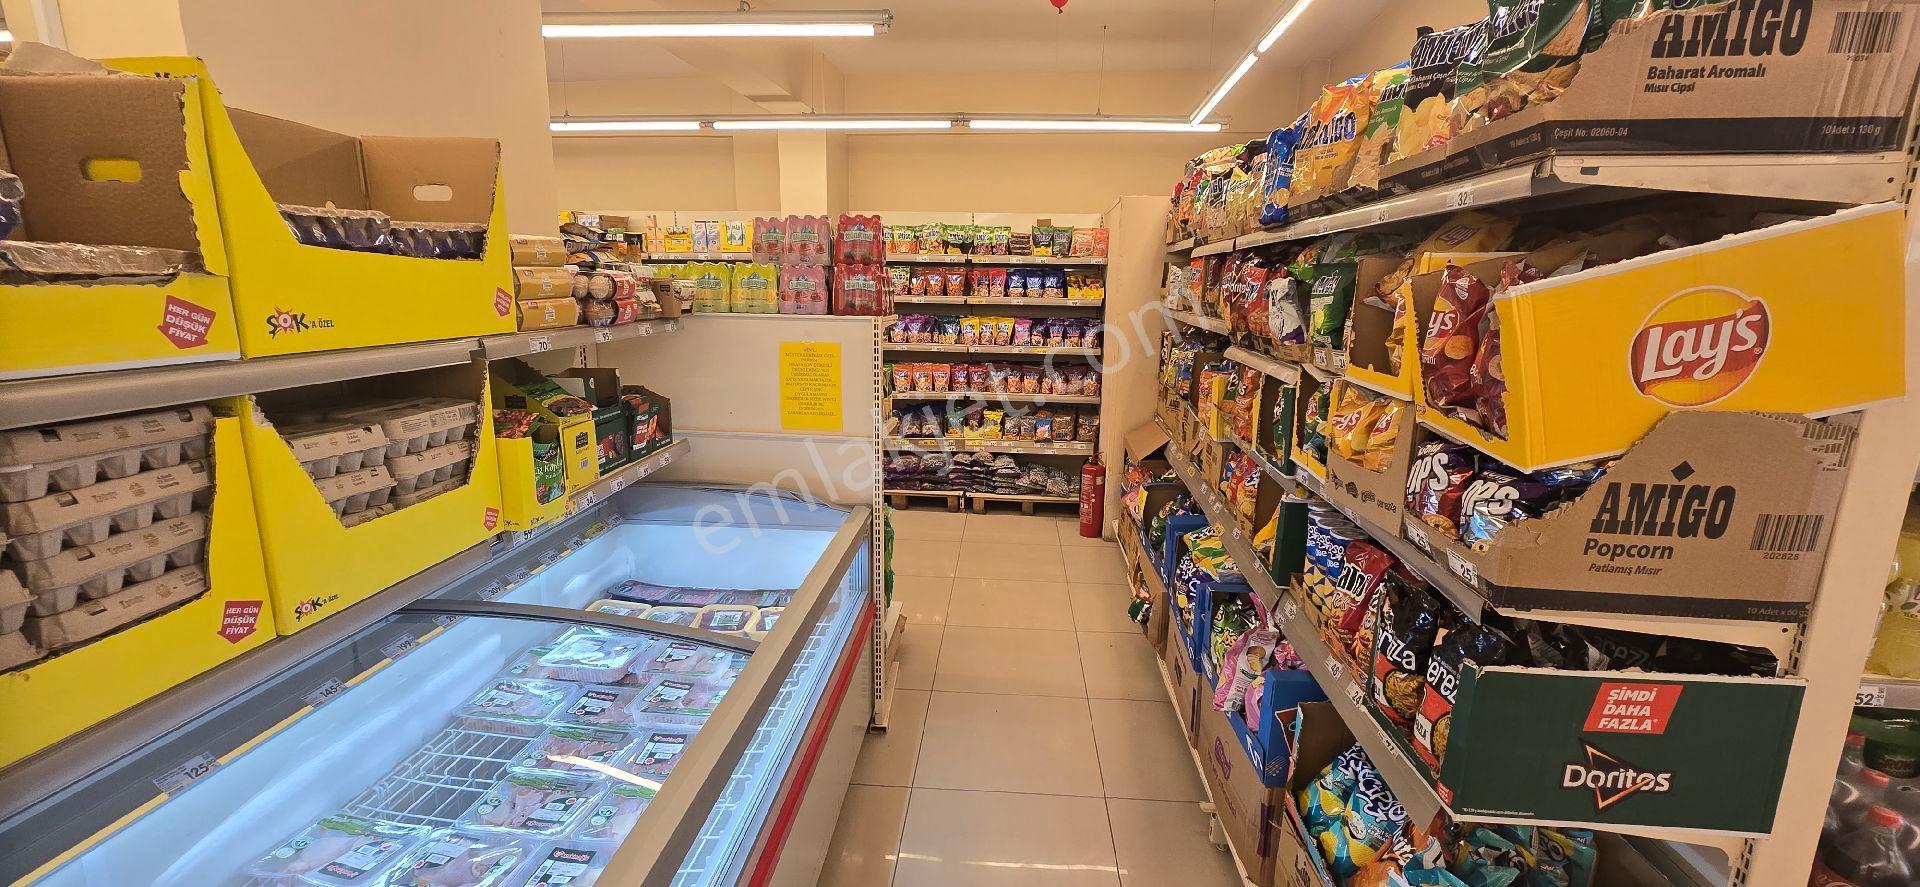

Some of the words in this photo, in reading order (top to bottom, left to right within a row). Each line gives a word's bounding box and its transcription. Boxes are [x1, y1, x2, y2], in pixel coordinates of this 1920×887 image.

[1647, 65, 1705, 80] Baharat
[1708, 63, 1766, 79] Aromalı
[1644, 83, 1669, 93] Mısır
[1670, 82, 1695, 94] Cipsi
[1575, 128, 1588, 137] No:
[1590, 128, 1628, 136] 02060-04
[1457, 193, 1468, 206] 32
[168, 304, 190, 316] HER
[191, 312, 210, 324] GÜN
[166, 314, 207, 334] DÜŞÜK
[318, 318, 334, 328] ÖZEL
[168, 327, 198, 342] FİYAT
[539, 342, 548, 351] 70
[1640, 308, 1761, 382] Lay's
[1584, 538, 1674, 562] Popcorn
[1460, 564, 1472, 580] 25
[1588, 563, 1632, 576] Patlamış
[1634, 565, 1662, 576] Mısır
[243, 606, 259, 614] GÜN
[224, 616, 256, 626] DÜŞÜK
[226, 626, 249, 635] FİYAT
[320, 685, 338, 698] 145
[1608, 686, 1657, 704] ŞİMDİ
[1854, 693, 1874, 706] 52
[1602, 704, 1651, 717] DAHA
[184, 764, 208, 780] 125
[1562, 764, 1672, 793] Doritos
